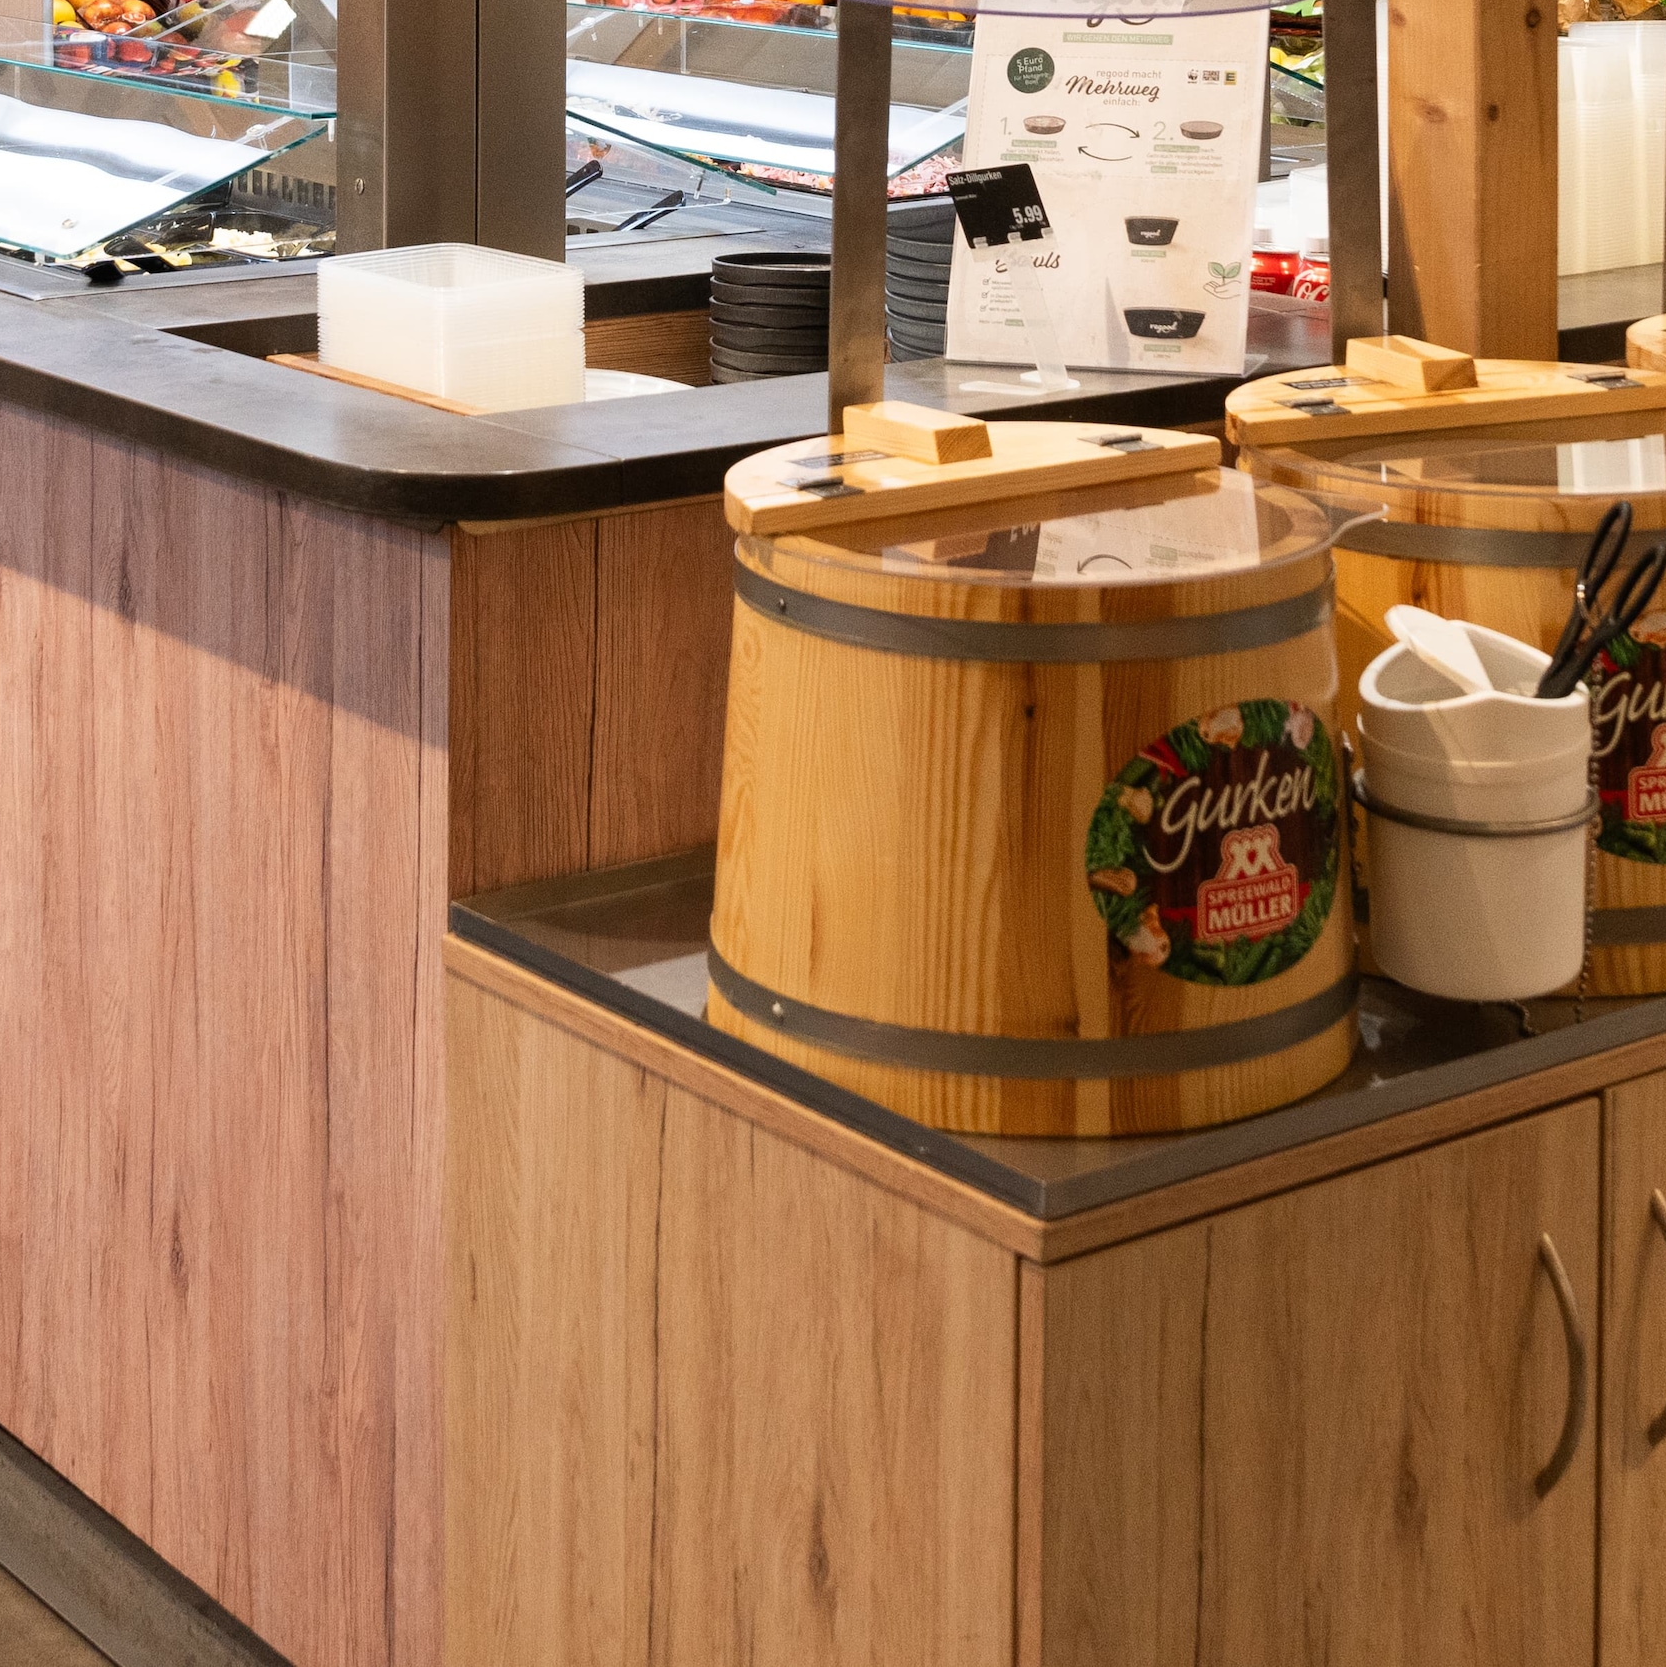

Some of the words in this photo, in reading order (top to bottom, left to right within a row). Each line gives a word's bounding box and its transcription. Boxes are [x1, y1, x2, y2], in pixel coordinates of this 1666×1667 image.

[1082, 35, 1109, 43] GEHEN
[1111, 35, 1127, 43] DEN
[1129, 36, 1170, 44] MEHRWEG
[1016, 59, 1022, 67] 5
[1023, 57, 1043, 65] Euro
[1018, 64, 1043, 73] Pfand
[1096, 70, 1129, 79] regood
[1132, 70, 1162, 78] macht
[1066, 75, 1161, 103] Mehrweg
[948, 171, 1002, 186] Salz-Dillgurken
[1012, 205, 1044, 224] 5.99
[1142, 750, 1316, 873] Gurken
[1207, 876, 1292, 905] SPREEWALD
[1208, 894, 1293, 931] MÜLLER
